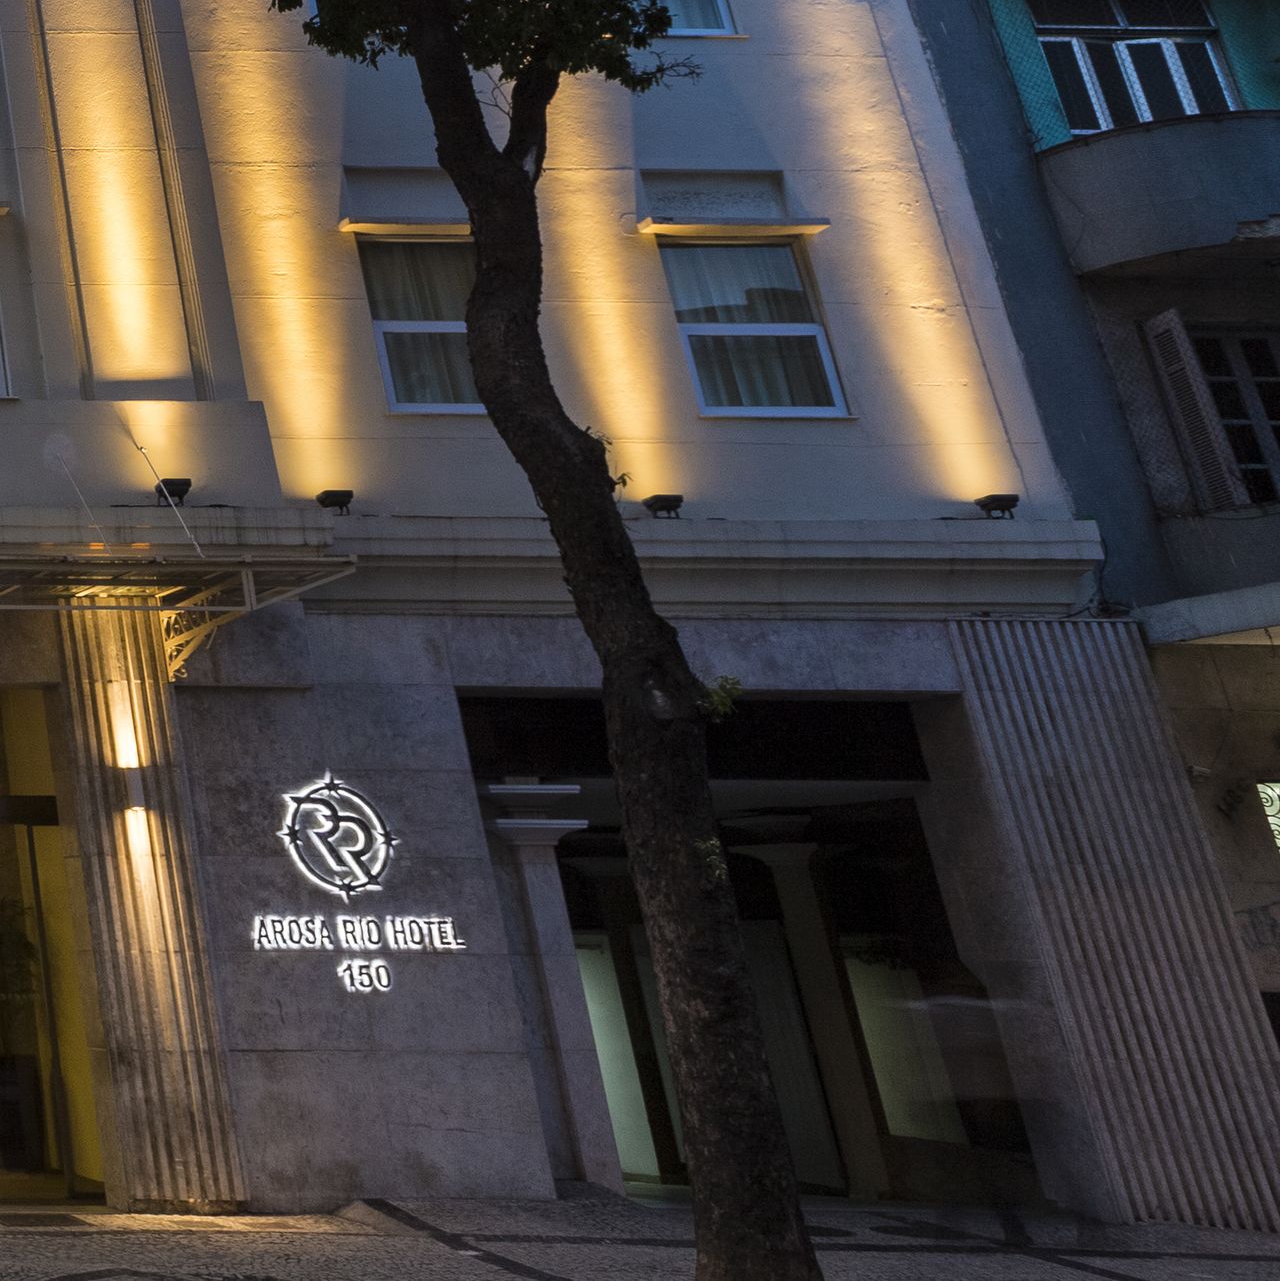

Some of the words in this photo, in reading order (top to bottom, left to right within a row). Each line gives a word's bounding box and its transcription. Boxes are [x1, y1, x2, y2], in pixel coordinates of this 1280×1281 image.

[252, 915, 334, 951] AROSA
[336, 915, 382, 951] RIO
[385, 915, 467, 951] HOTEL
[337, 958, 391, 993] 150
